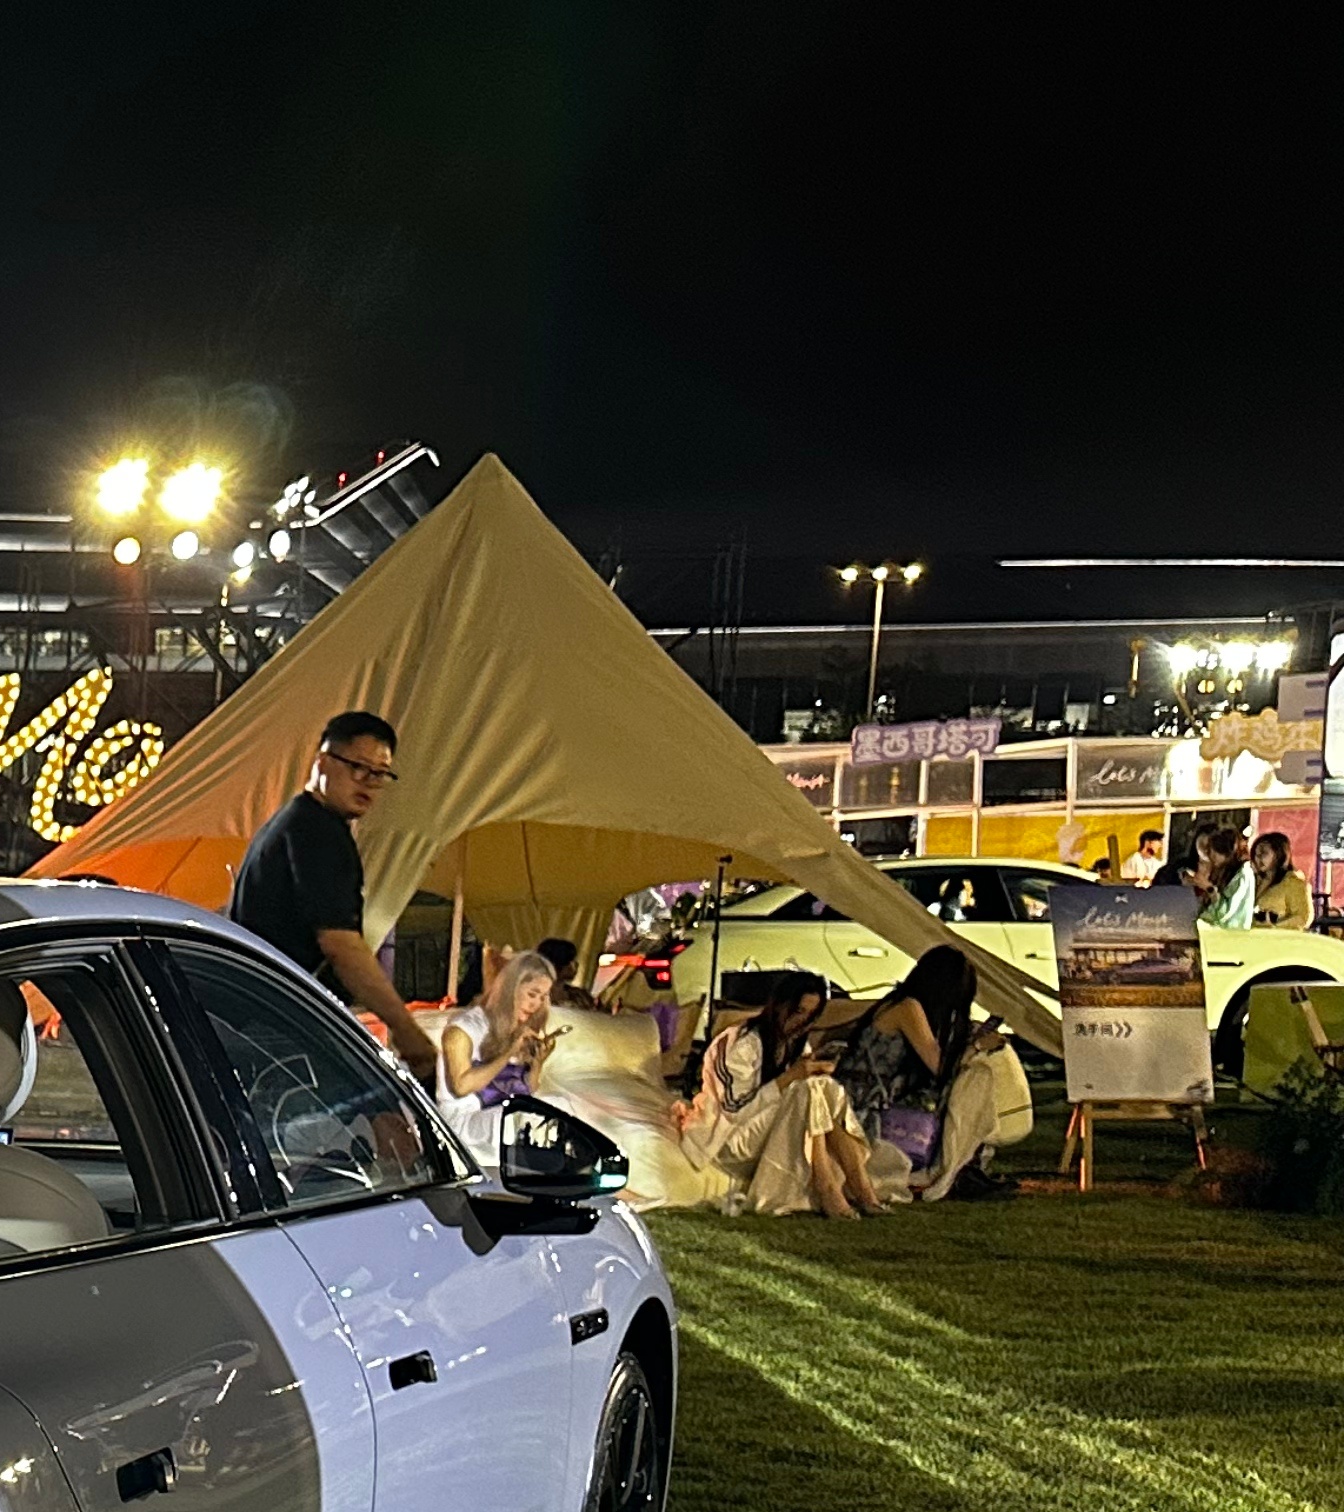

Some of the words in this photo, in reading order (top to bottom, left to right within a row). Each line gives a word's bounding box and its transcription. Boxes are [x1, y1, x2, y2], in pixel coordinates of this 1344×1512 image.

[855, 723, 998, 762] 墨西哥塔可
